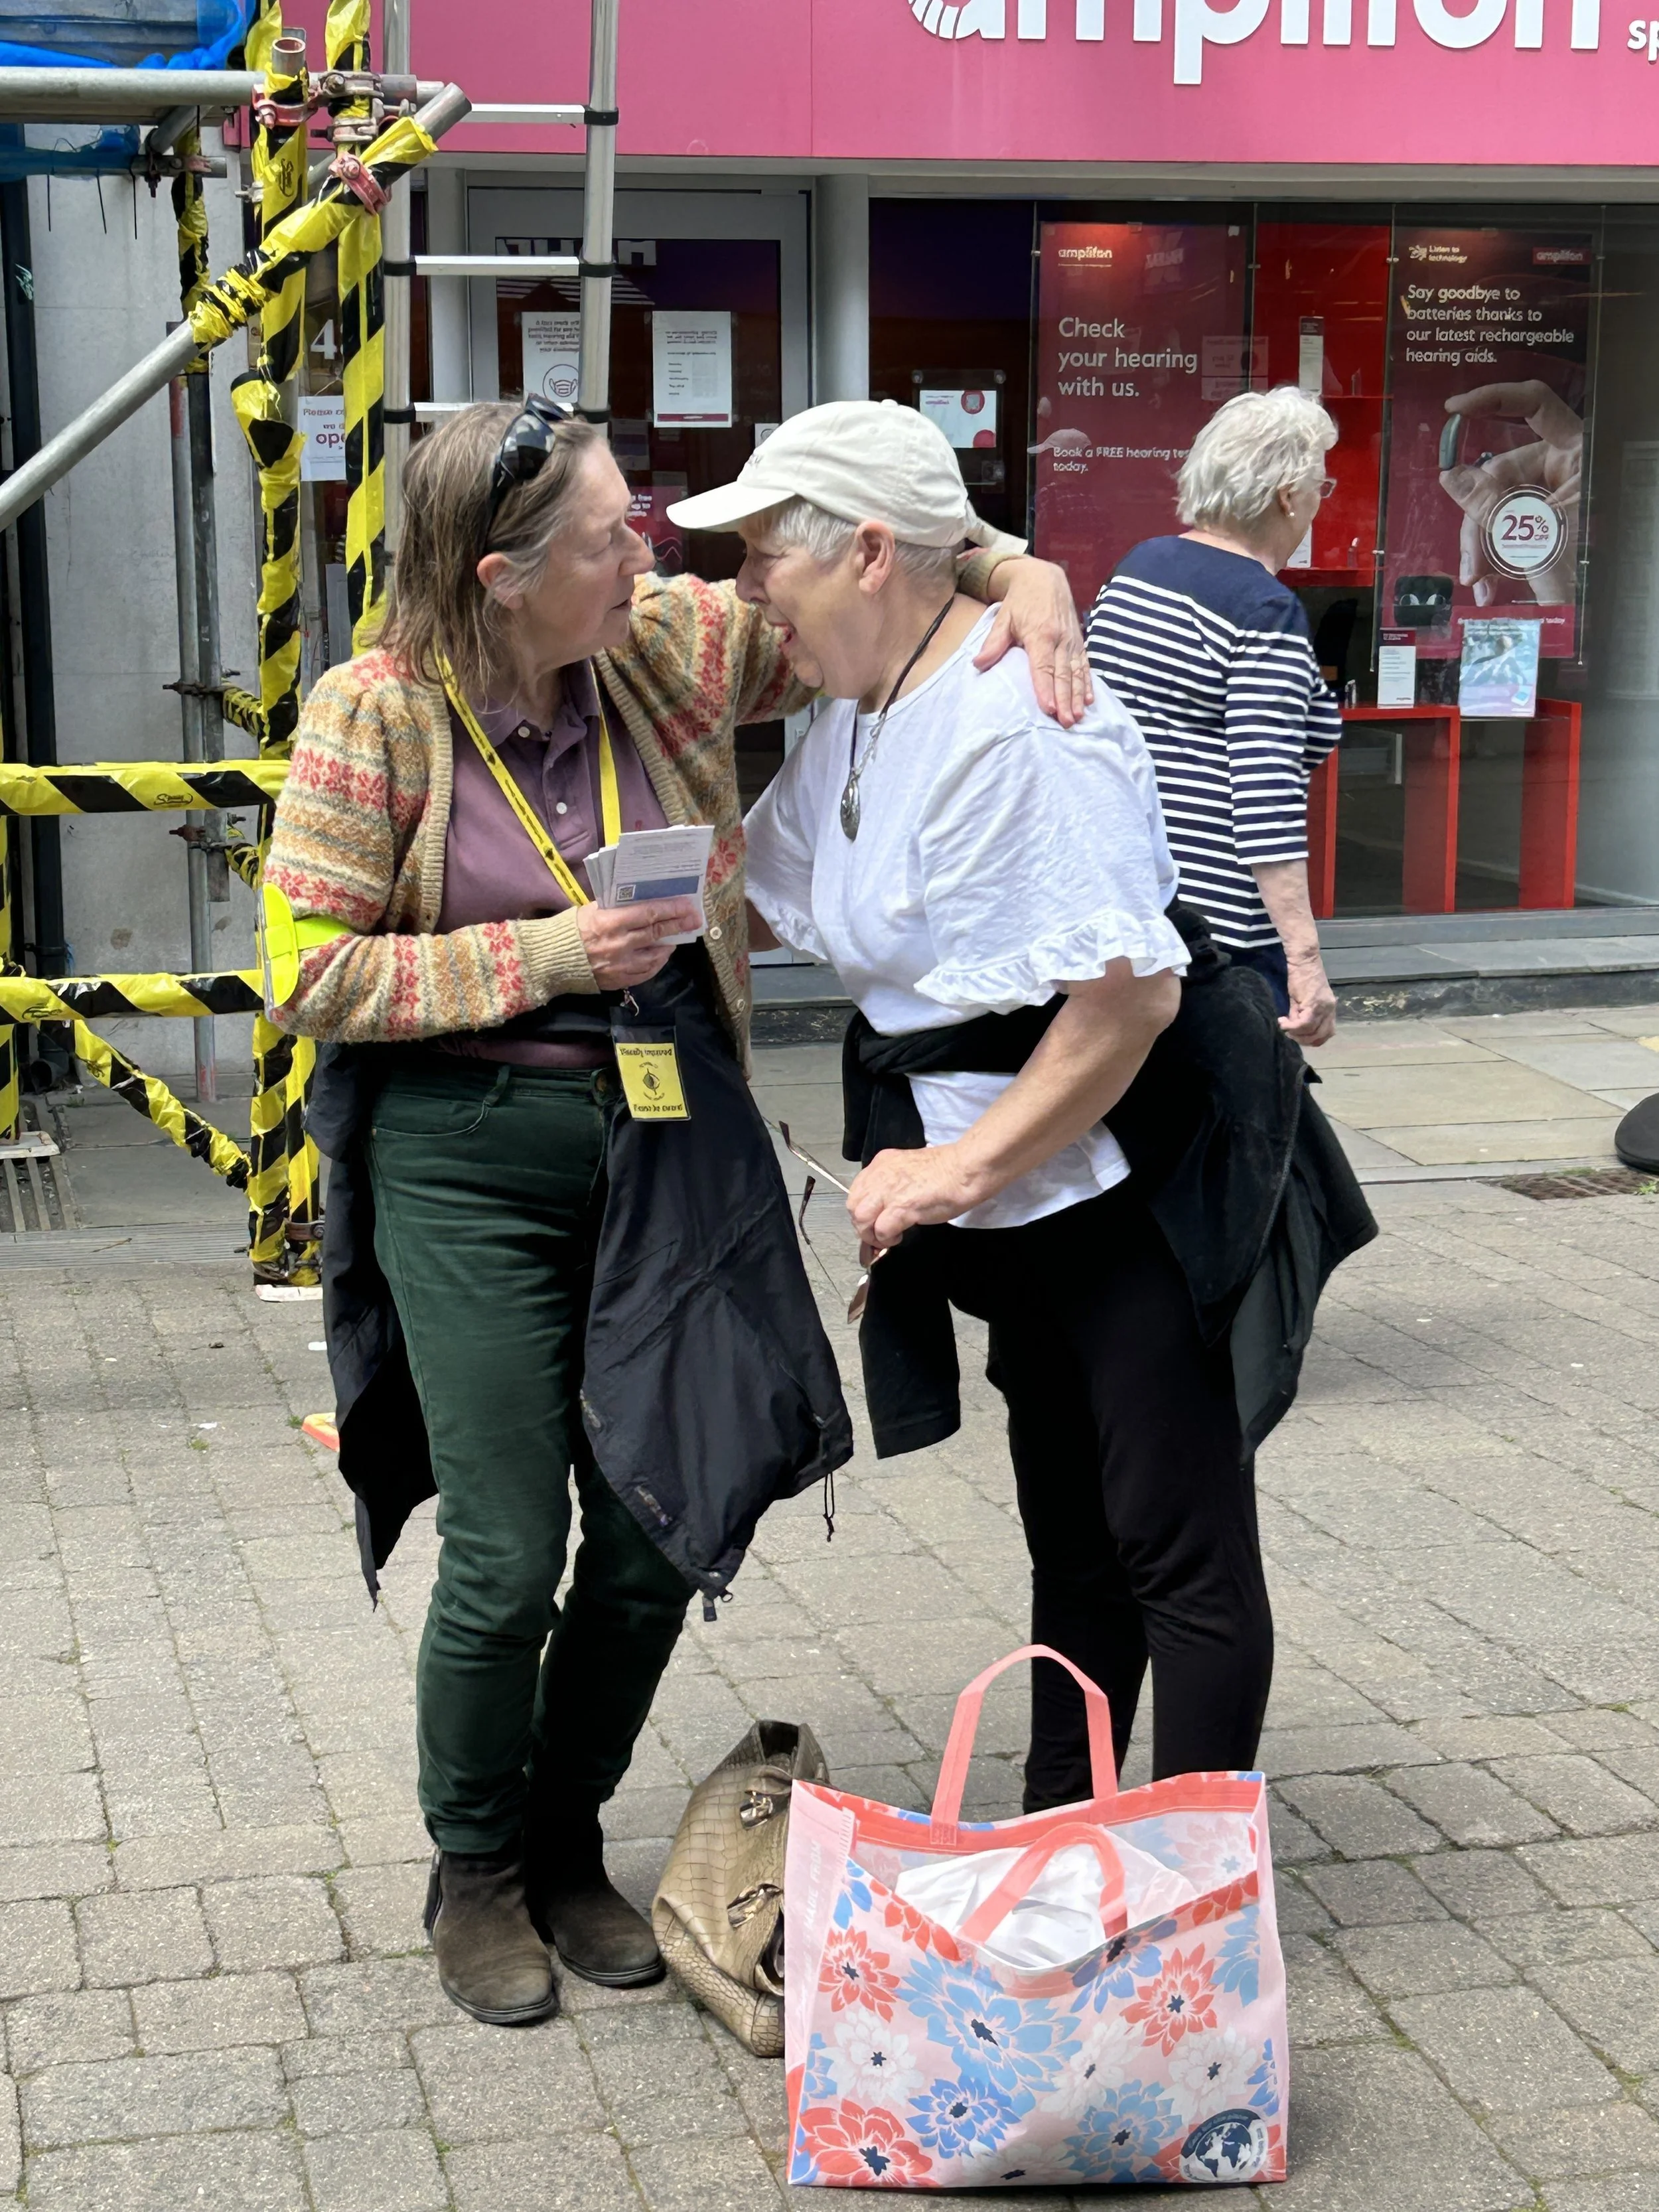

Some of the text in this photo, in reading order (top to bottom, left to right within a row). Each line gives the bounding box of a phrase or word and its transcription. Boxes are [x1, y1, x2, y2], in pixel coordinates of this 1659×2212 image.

[1407, 284, 1521, 303] Say goodbye to
[1406, 305, 1542, 322] batteries thanks to
[1058, 317, 1125, 338] Check
[1406, 327, 1574, 346] our latest rechargeable
[1058, 351, 1108, 372] your
[1114, 347, 1198, 373] hearing
[1406, 347, 1497, 366] hearing aids.
[1058, 376, 1140, 398] with us.
[1053, 447, 1082, 457] Book
[1096, 447, 1124, 458] FREE
[1126, 447, 1171, 461] hearing
[1053, 461, 1089, 474] today.
[1501, 514, 1549, 541] 25%
